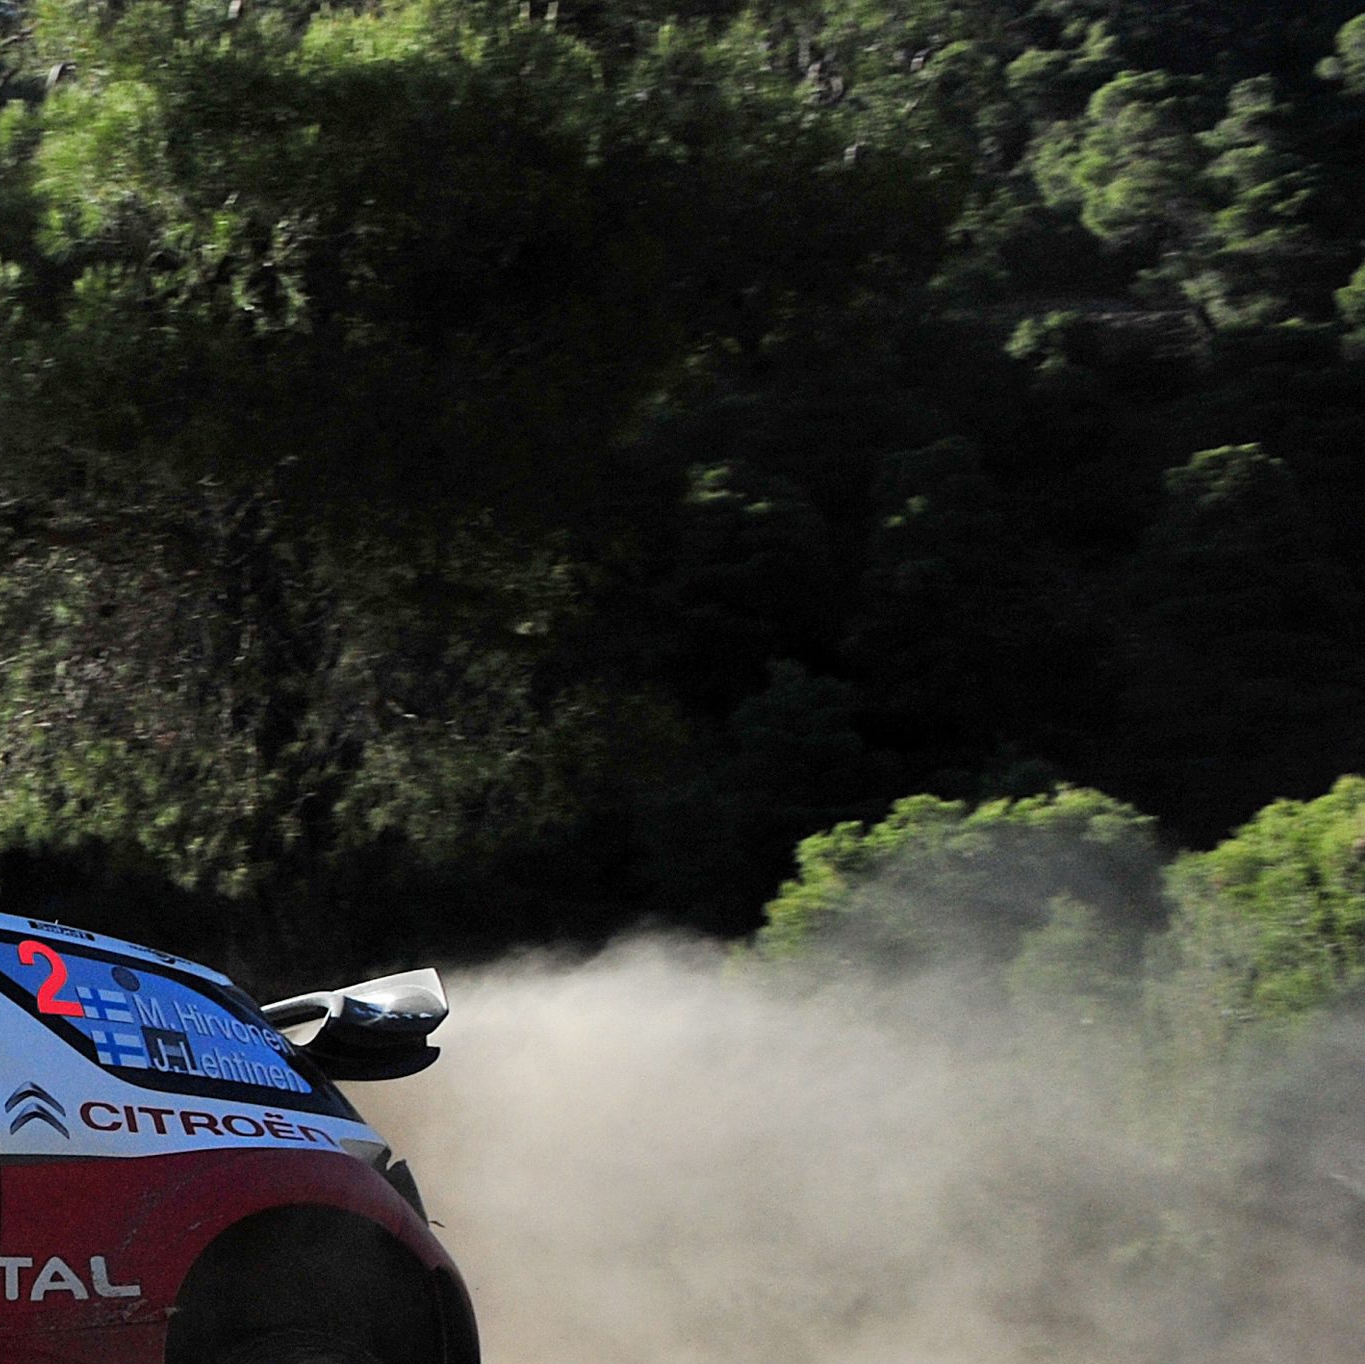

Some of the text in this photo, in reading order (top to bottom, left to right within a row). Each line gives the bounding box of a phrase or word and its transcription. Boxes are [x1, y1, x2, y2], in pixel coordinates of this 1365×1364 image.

[19, 940, 85, 1018] 2
[173, 1001, 297, 1056] Hirvonen
[179, 1041, 305, 1094] Lehtinen
